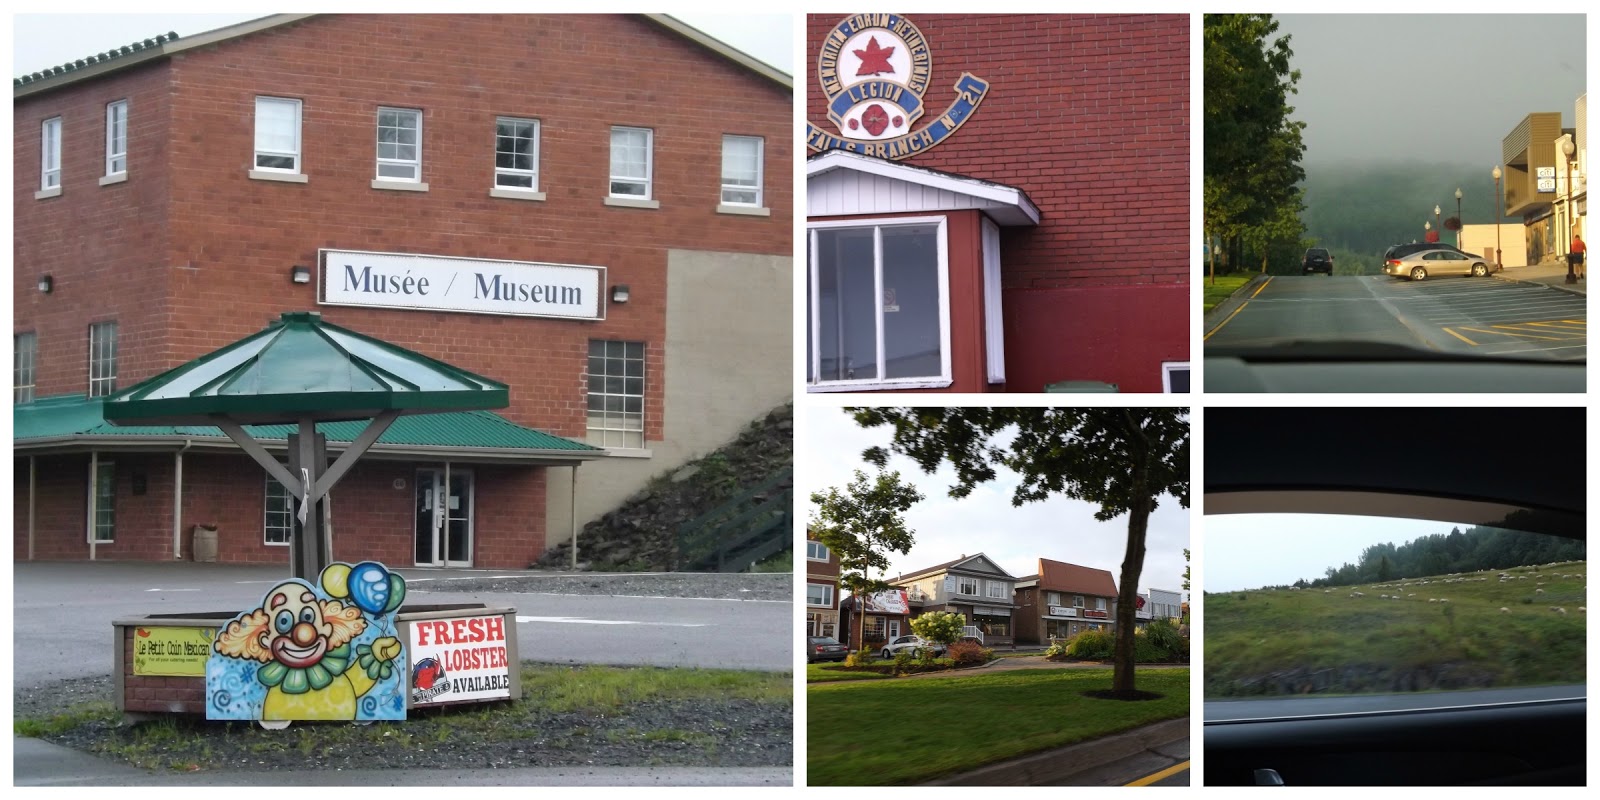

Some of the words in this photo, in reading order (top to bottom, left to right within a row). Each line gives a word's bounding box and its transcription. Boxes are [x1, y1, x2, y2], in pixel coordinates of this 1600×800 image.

[847, 82, 903, 103] LEGION
[864, 130, 934, 158] BRANCH
[962, 84, 982, 106] 21
[343, 264, 430, 296] Musée
[474, 273, 582, 305] Museum
[416, 618, 504, 646] FRESH
[139, 641, 146, 655] Le
[148, 640, 165, 655] Petit
[167, 640, 182, 655] Coin
[184, 640, 210, 656] Mexican
[444, 646, 508, 672] LOBSTER
[452, 674, 509, 693] AVAILABLE
